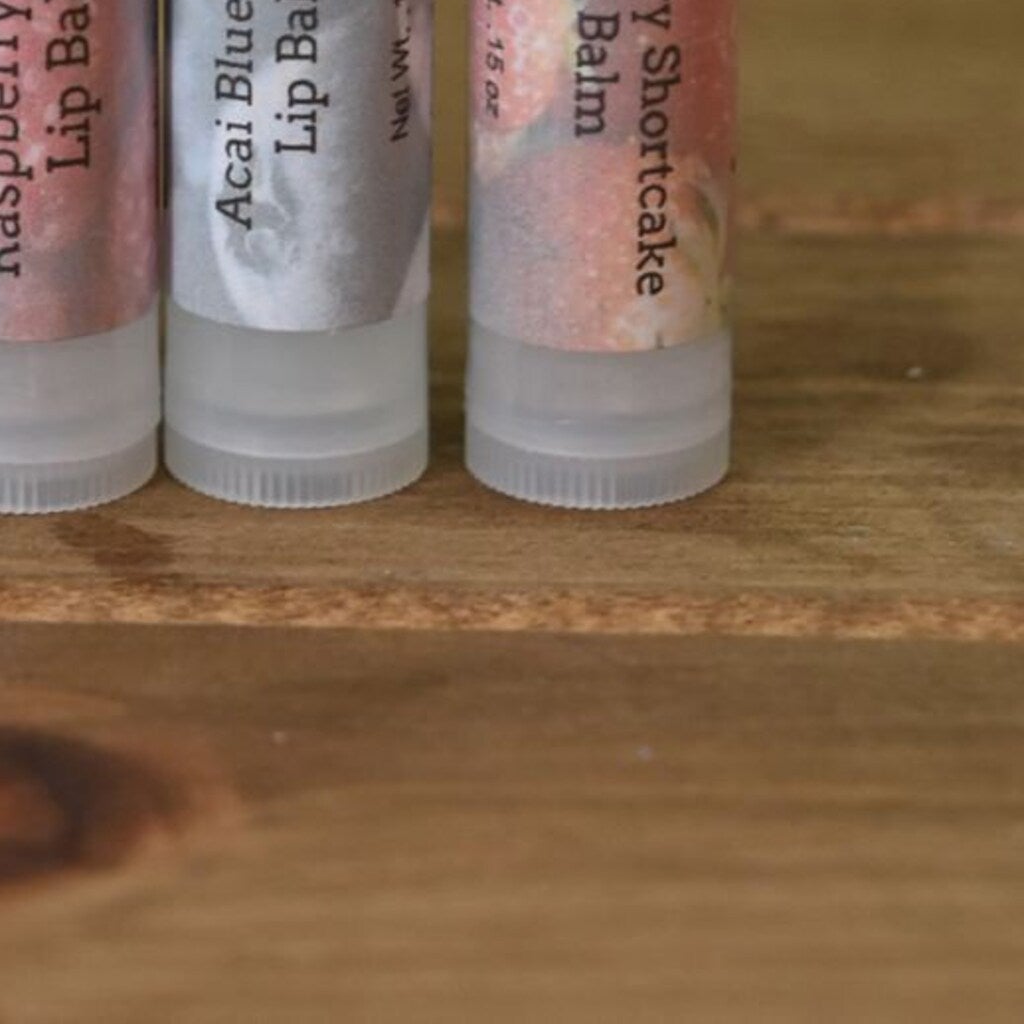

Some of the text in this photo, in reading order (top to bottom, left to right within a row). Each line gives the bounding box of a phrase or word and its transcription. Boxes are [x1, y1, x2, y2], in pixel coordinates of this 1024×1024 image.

[390, 24, 413, 80] Wt.
[485, 23, 505, 74] .15
[574, 11, 621, 139] Balm
[46, 83, 100, 173] Lip
[276, 78, 328, 155] Lip
[389, 86, 412, 143] Net
[484, 80, 502, 118] oz
[214, 120, 253, 231] Acai
[635, 45, 683, 297] Shortcake
